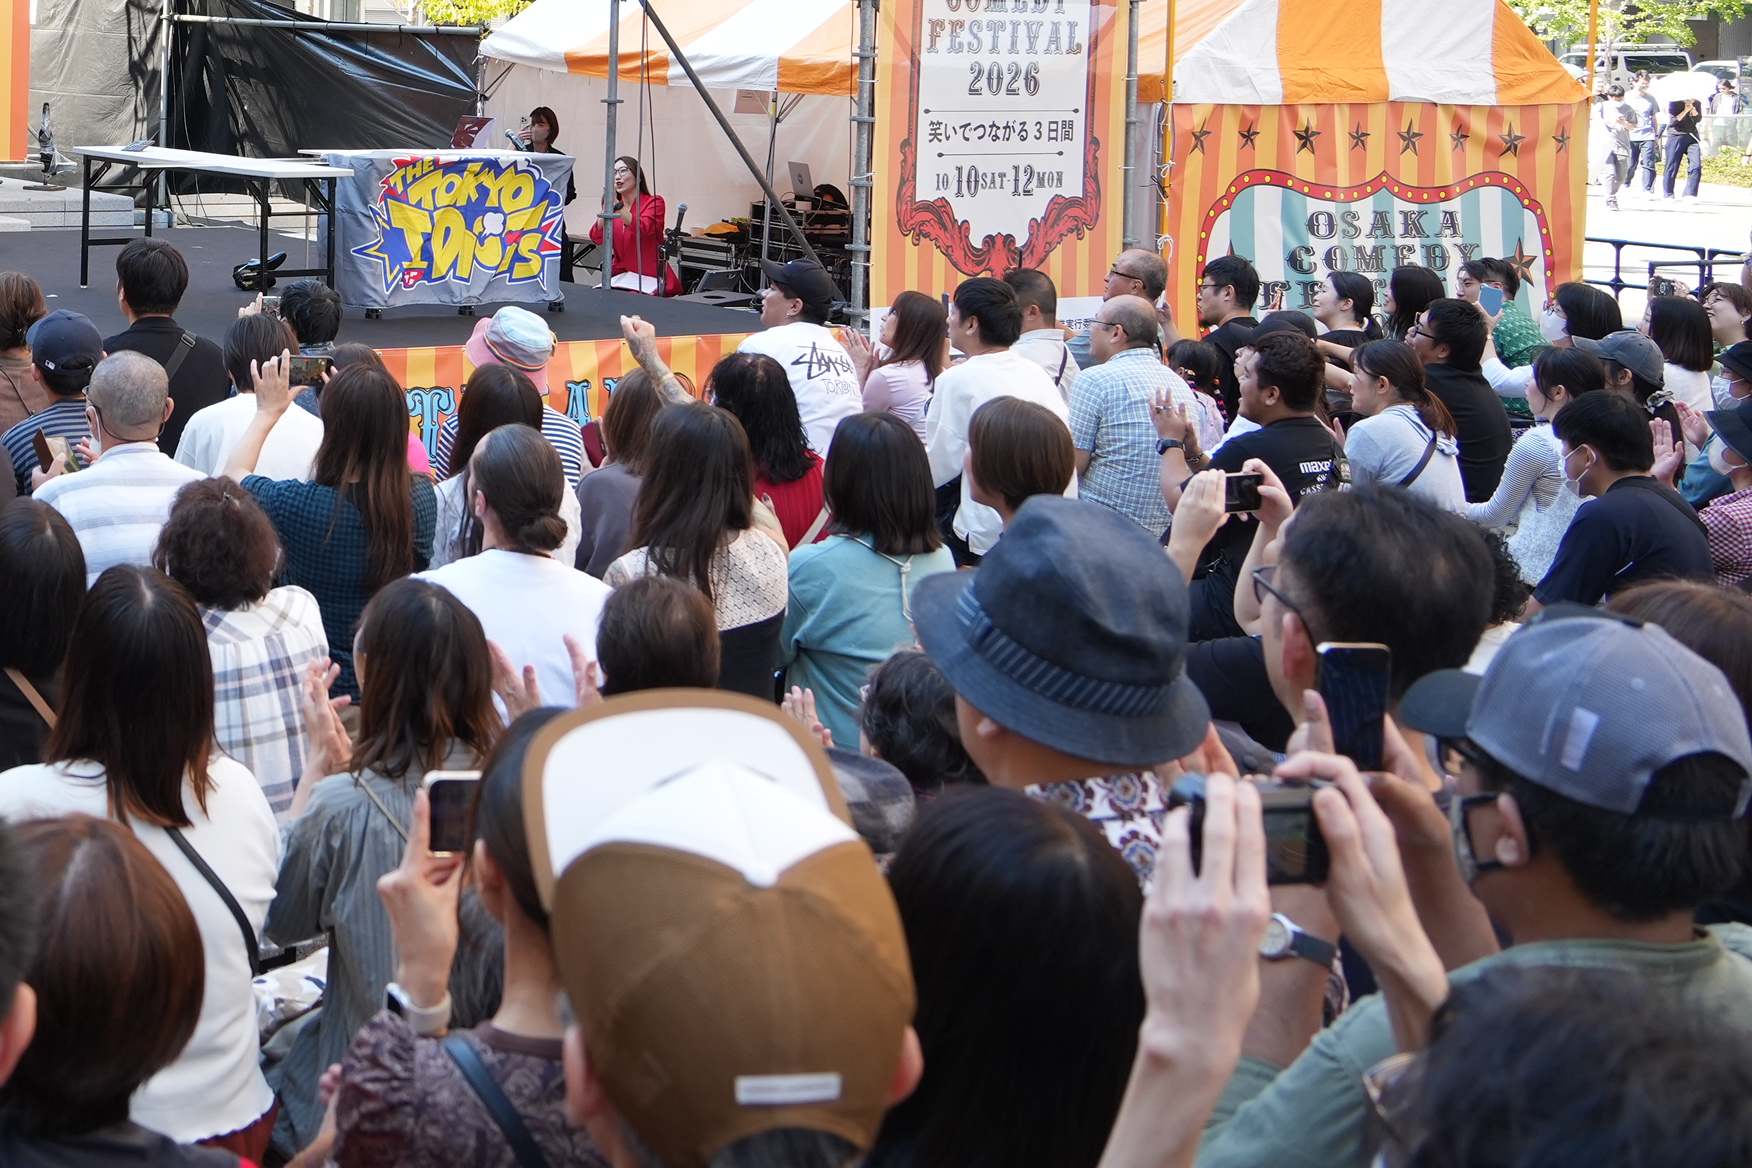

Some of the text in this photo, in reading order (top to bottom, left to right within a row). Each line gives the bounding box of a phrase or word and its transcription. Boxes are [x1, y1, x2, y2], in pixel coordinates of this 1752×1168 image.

[926, 17, 1083, 55] FESTIVAL
[968, 60, 1041, 97] 2026
[389, 157, 435, 194] THE
[407, 162, 534, 213] TOKYO
[1306, 209, 1464, 240] OSAKA
[1286, 242, 1480, 275] COMEDY
